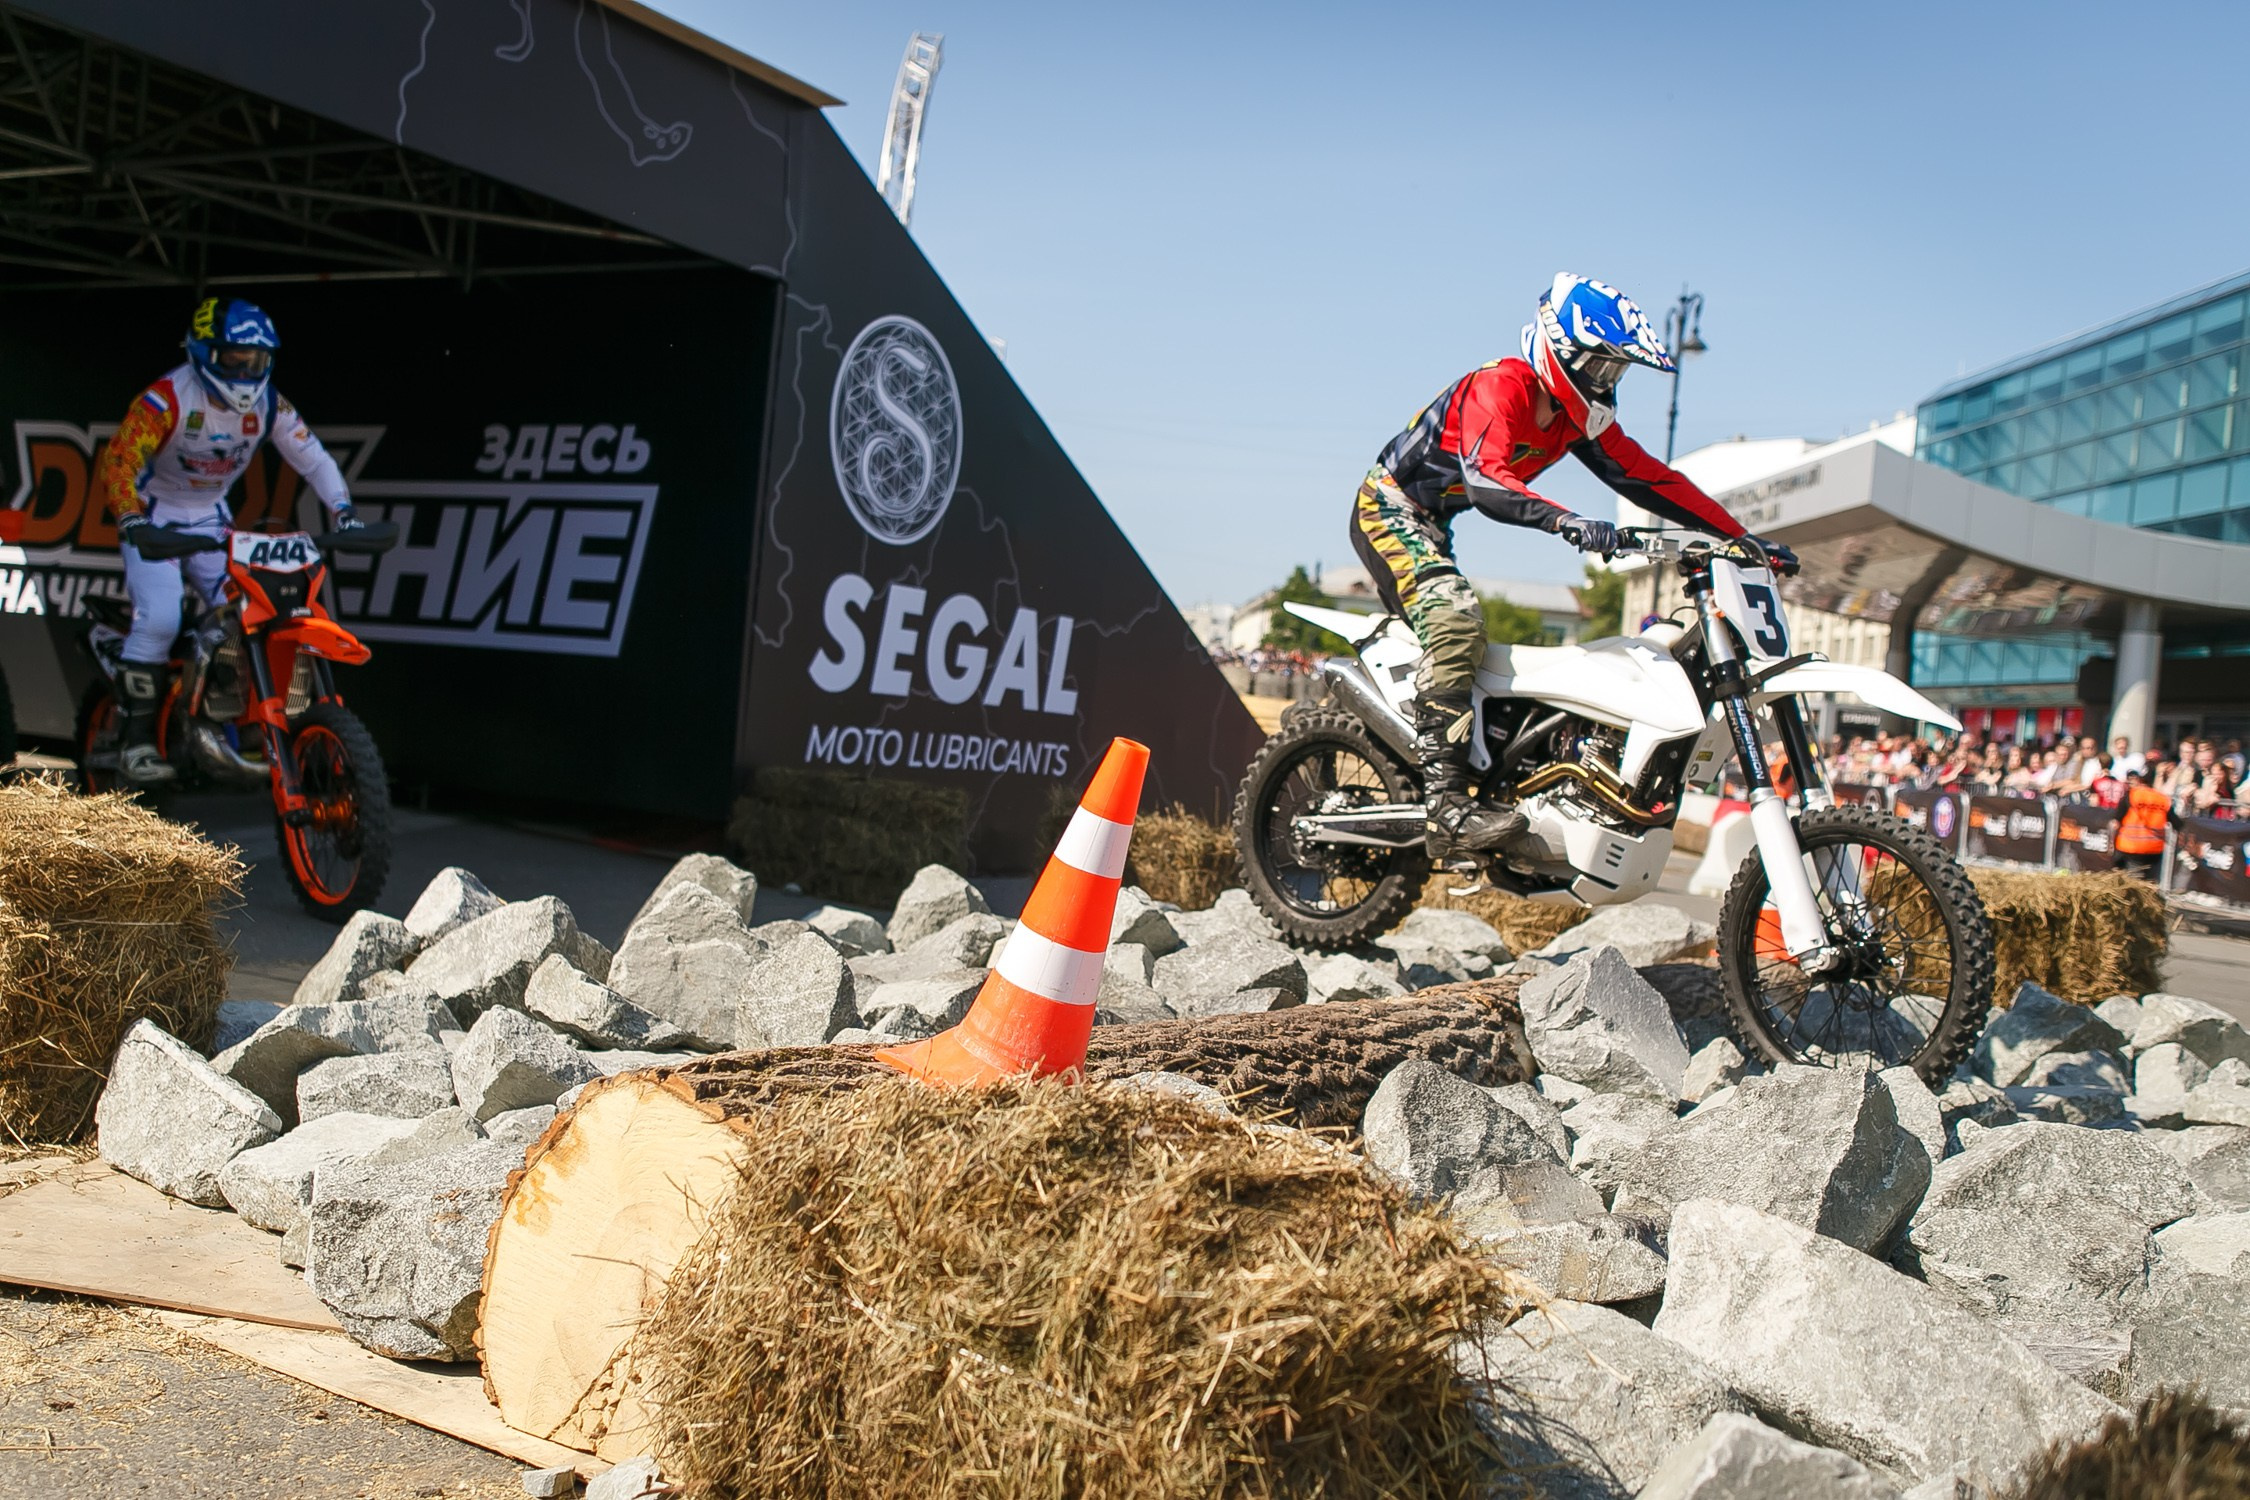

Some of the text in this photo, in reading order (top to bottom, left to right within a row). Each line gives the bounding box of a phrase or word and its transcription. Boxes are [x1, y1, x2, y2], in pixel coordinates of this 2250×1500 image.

[1539, 300, 1578, 360] 100%
[1622, 343, 1661, 367] Airoh
[475, 424, 652, 481] ЗДЕСЬ
[249, 541, 308, 565] 444
[808, 573, 1079, 716] SEGAL
[1740, 583, 1789, 658] 3
[805, 725, 1070, 777] MOTO LUBRICANTS
[1733, 697, 1765, 780] SUSPENSION
